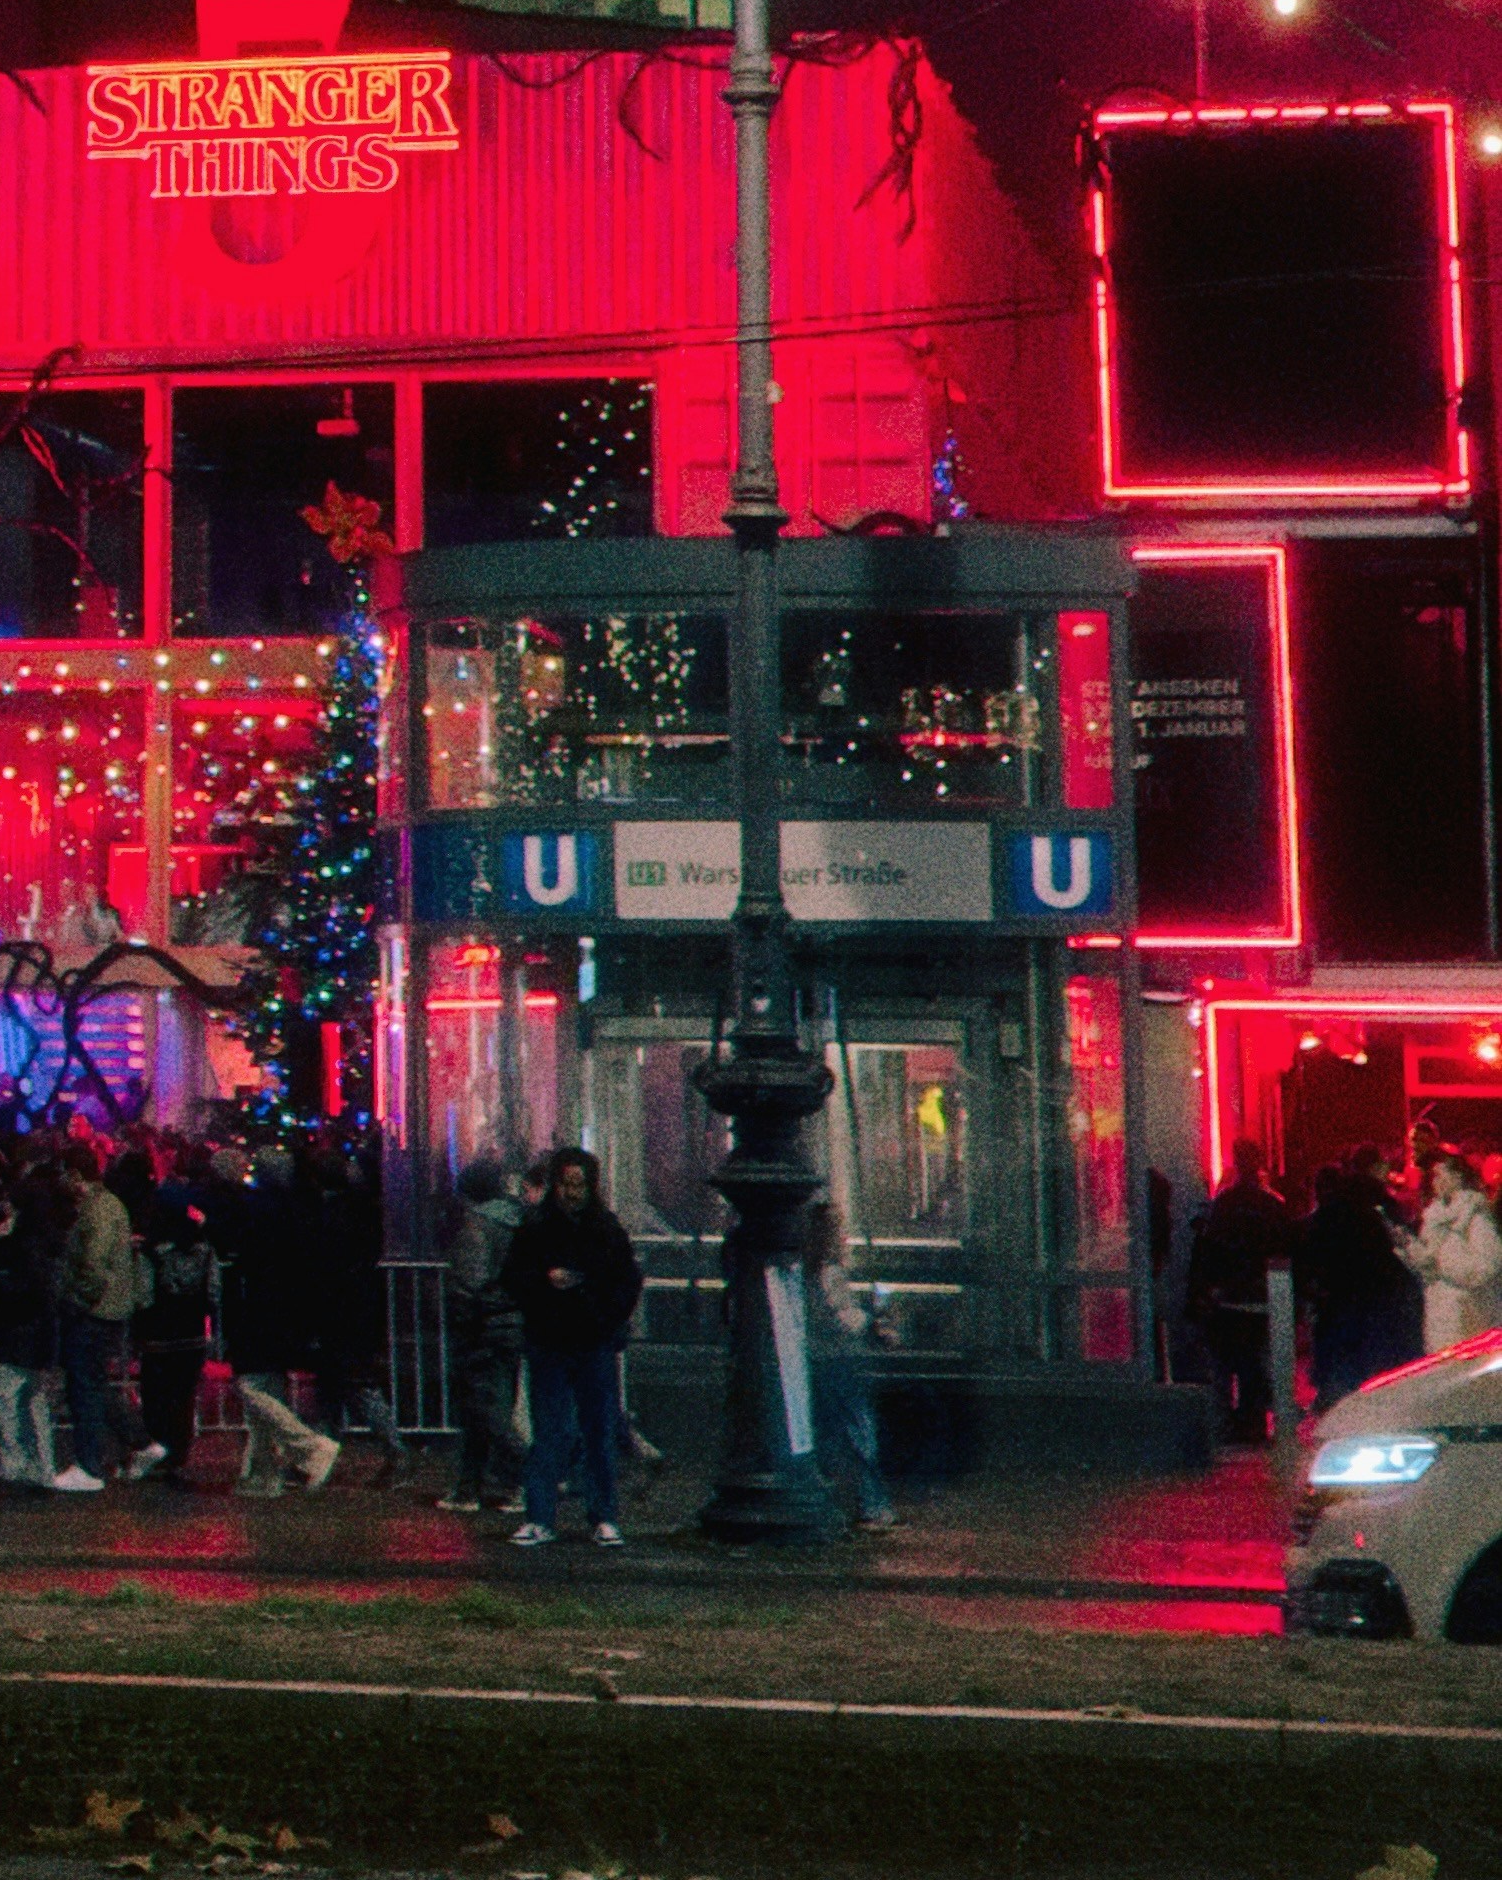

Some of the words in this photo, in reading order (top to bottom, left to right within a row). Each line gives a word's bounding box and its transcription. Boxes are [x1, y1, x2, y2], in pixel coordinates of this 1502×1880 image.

[86, 64, 459, 147] STRANGER
[150, 136, 399, 199] THINGS
[1130, 699, 1246, 718] DEZEMBER
[1160, 720, 1246, 738] JANUAR
[523, 834, 576, 906] U
[676, 862, 821, 886] Warsuer
[826, 860, 907, 886] Straße
[1031, 835, 1092, 909] U
